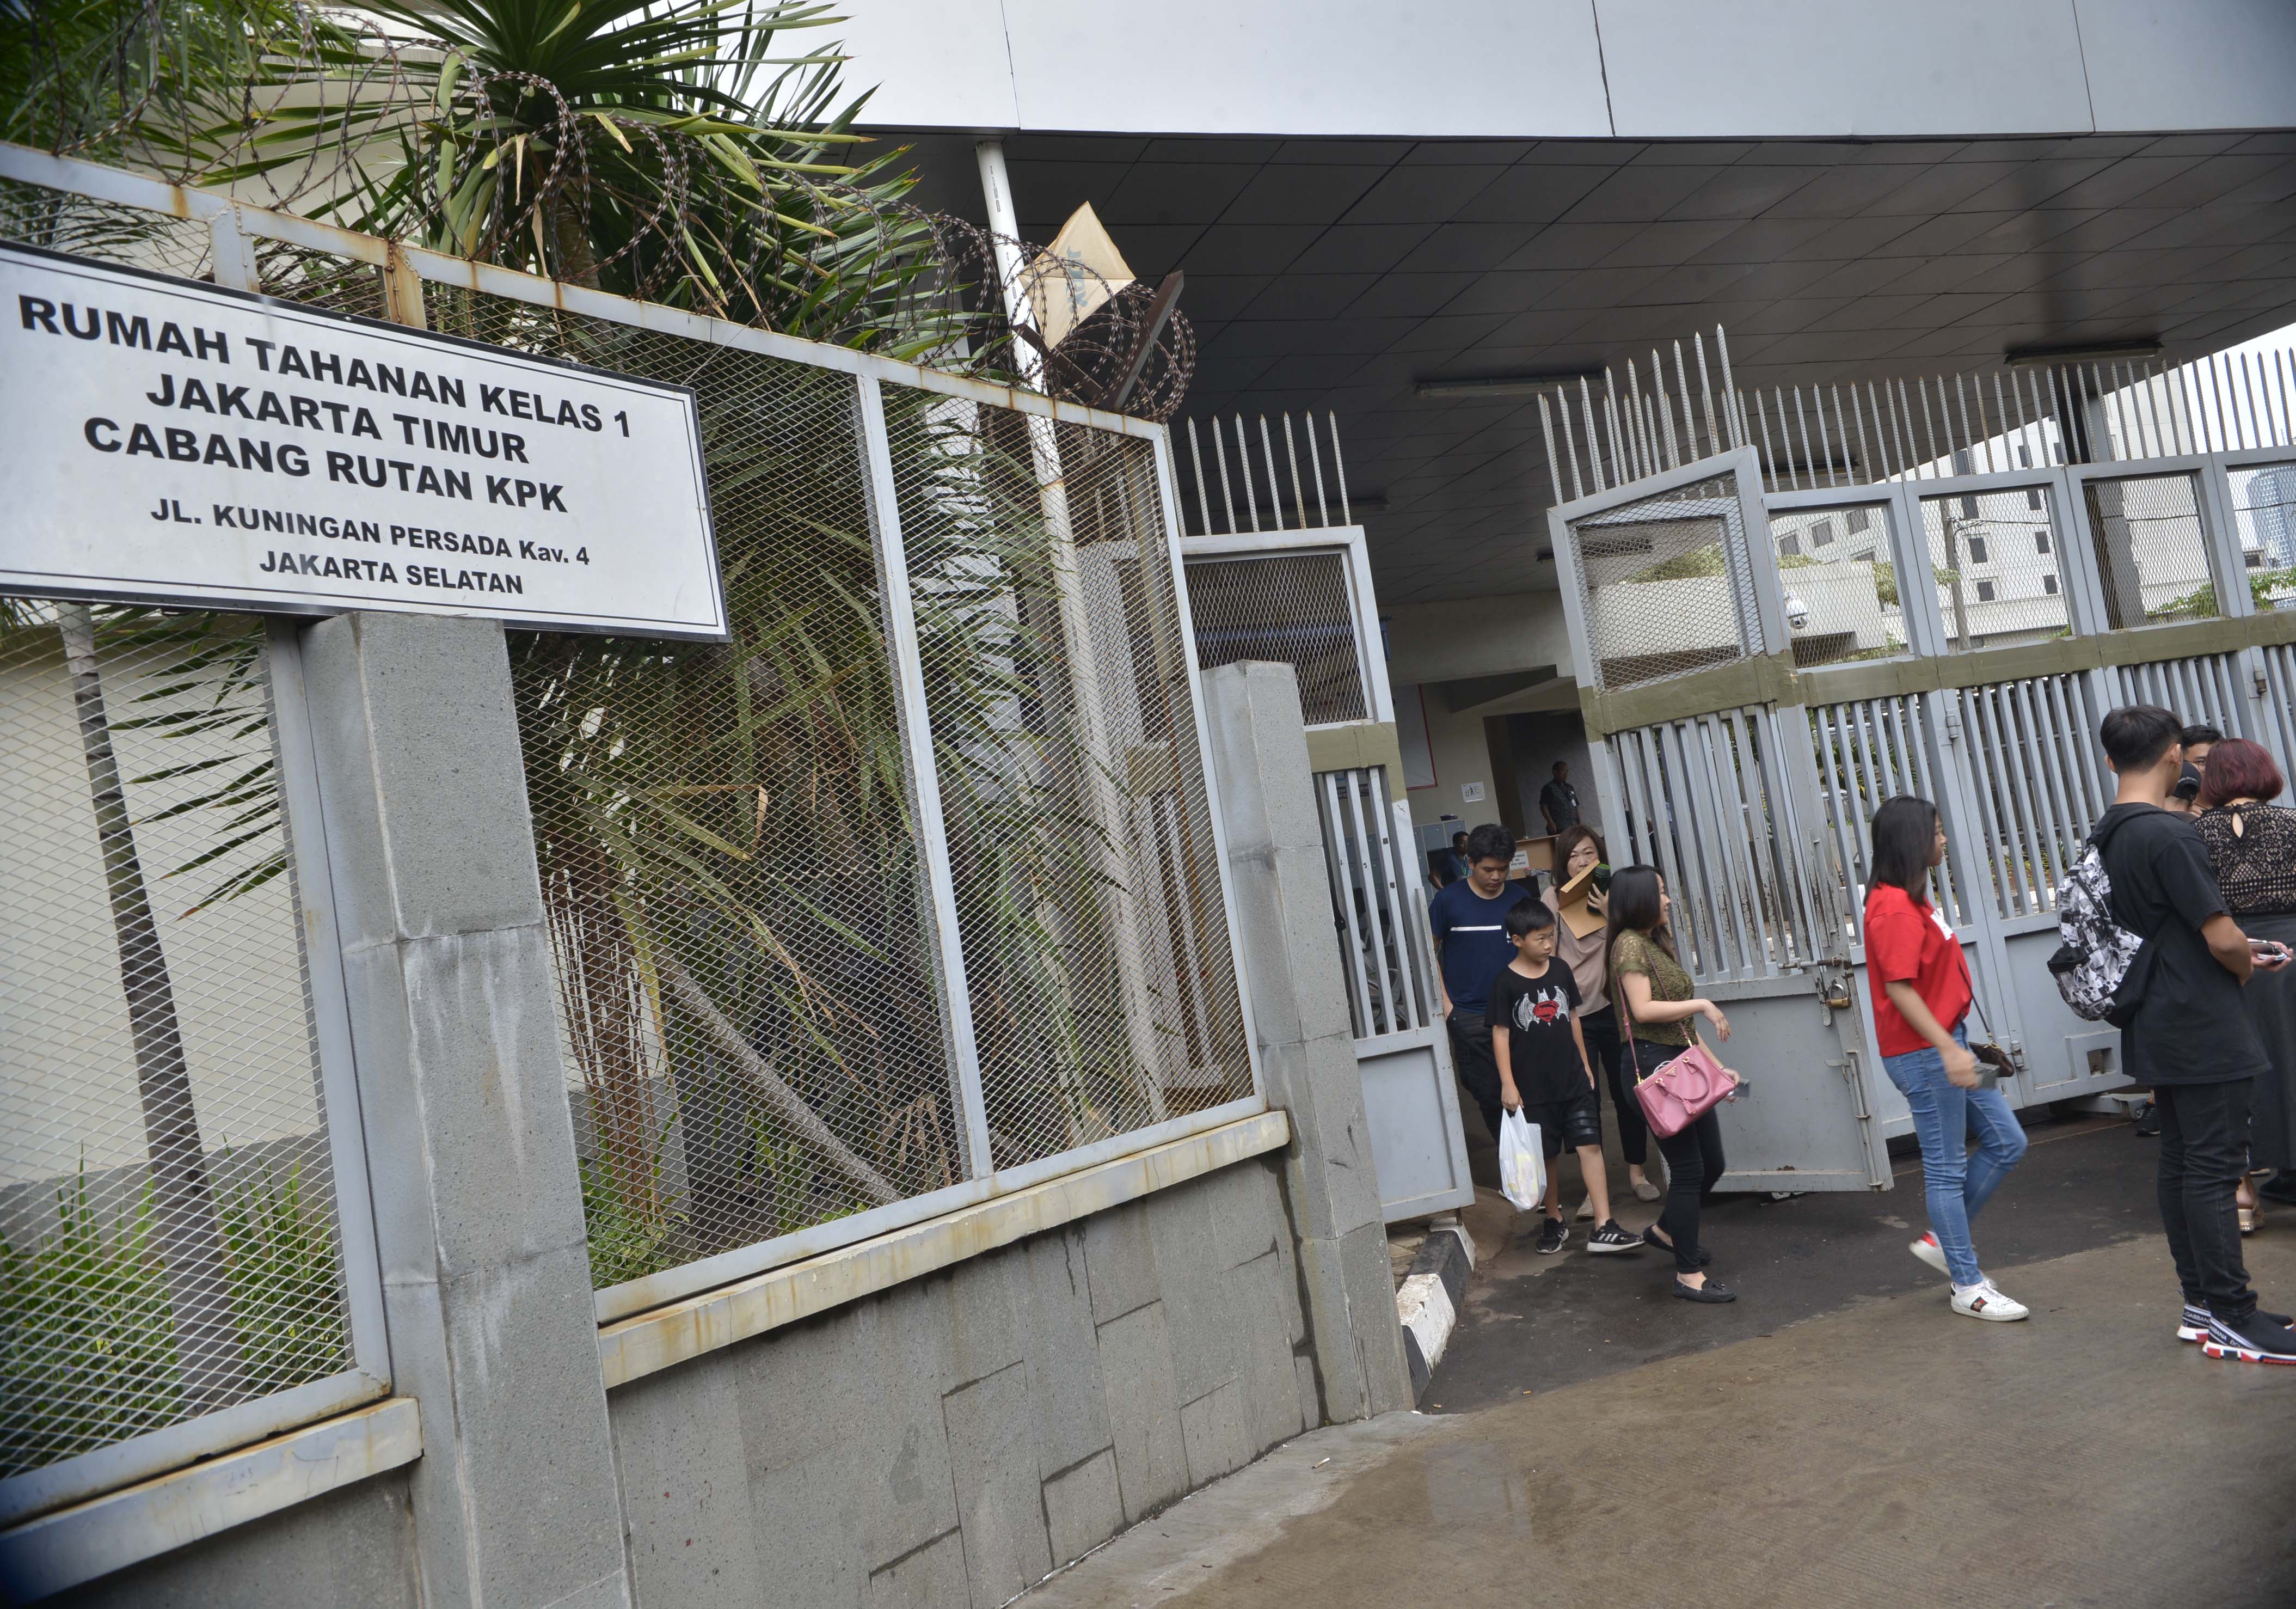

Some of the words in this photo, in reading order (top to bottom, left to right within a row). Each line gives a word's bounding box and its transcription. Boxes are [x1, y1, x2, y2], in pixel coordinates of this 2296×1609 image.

[19, 294, 230, 364] RUMAH
[245, 337, 466, 408] TAHANAN
[480, 383, 603, 432] KELAS
[614, 411, 629, 437] 1
[146, 374, 383, 440] JAKARTA
[392, 413, 530, 463] TIMUR
[84, 418, 310, 477] CABANG
[327, 451, 472, 500] RUTAN
[486, 475, 568, 512] KPK
[151, 499, 201, 524] JL.
[213, 504, 381, 543] KUNINGAN
[390, 525, 512, 558] PERSADA
[519, 540, 569, 564] Kav.
[576, 547, 590, 565] 4
[260, 550, 398, 583] JAKARTA
[407, 565, 523, 594] SELATAN
